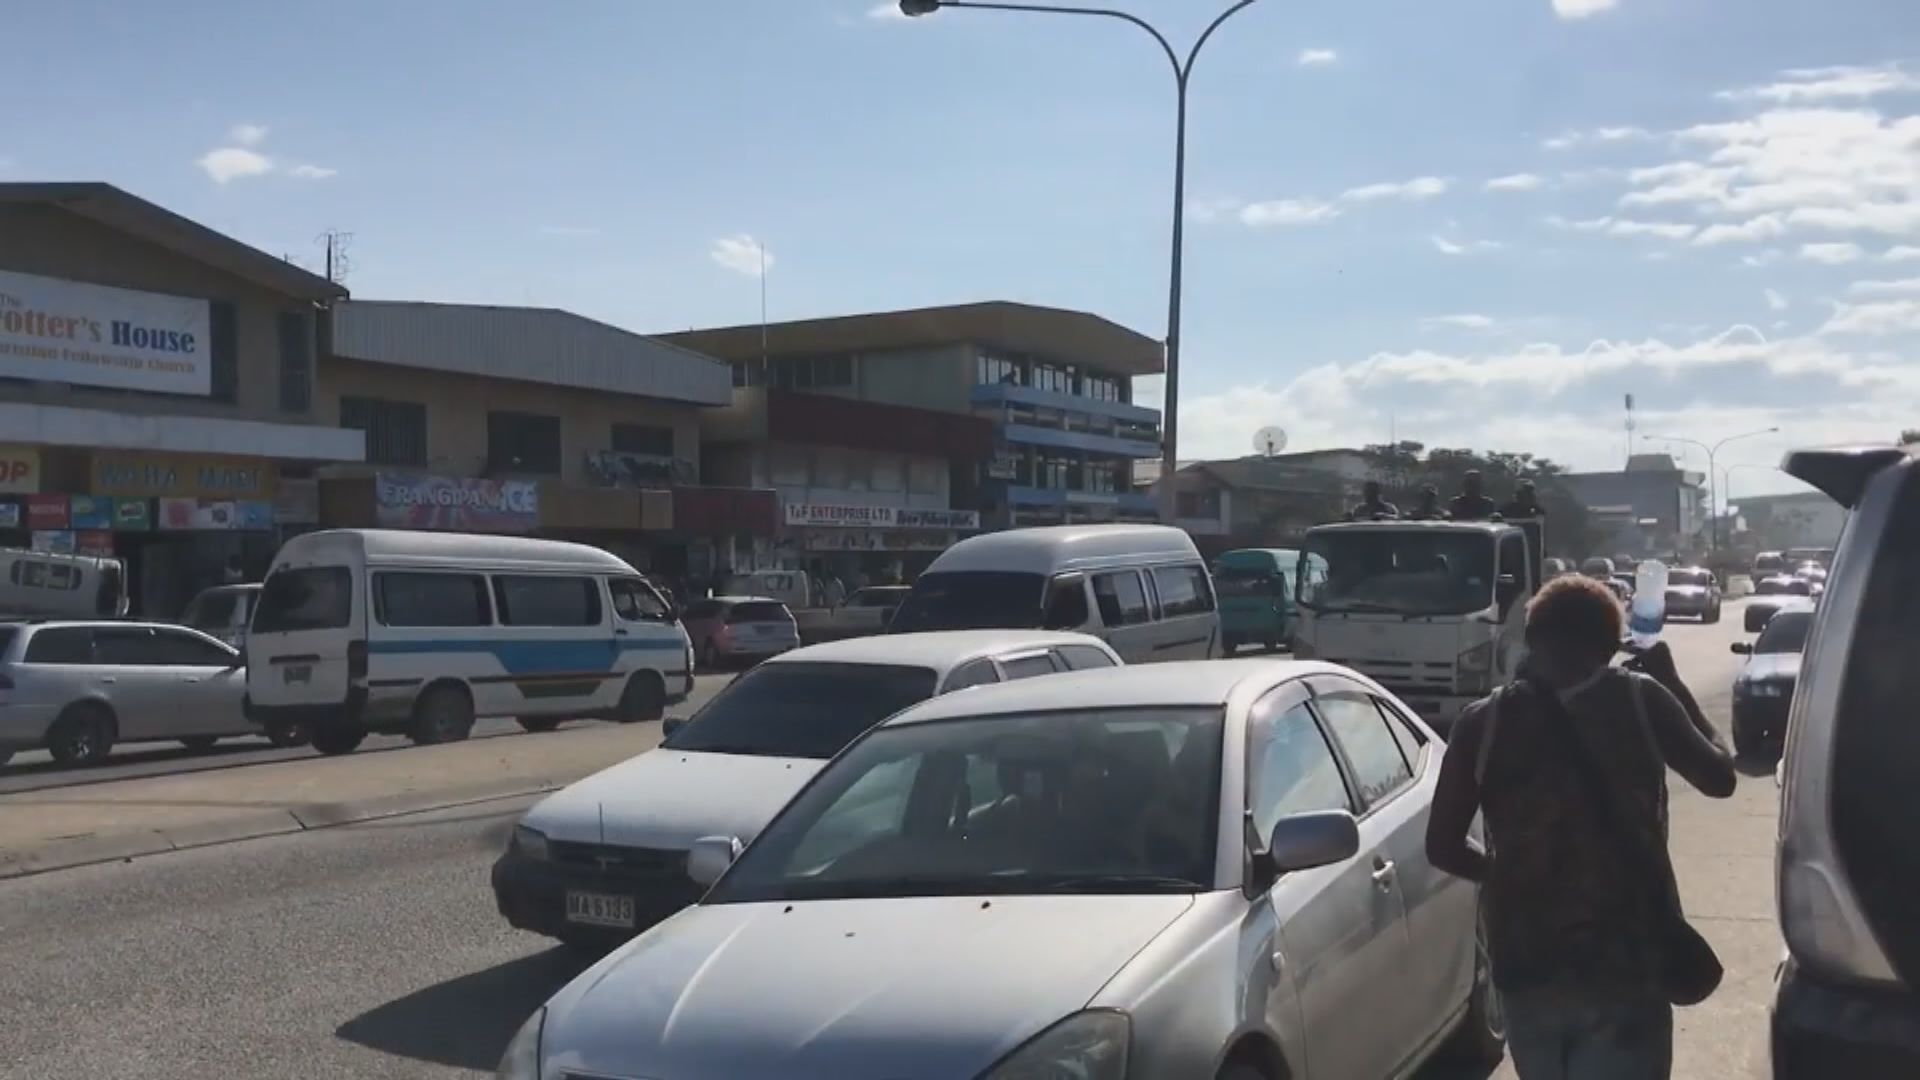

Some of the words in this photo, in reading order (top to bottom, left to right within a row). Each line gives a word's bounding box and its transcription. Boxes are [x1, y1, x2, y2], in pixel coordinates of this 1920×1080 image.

[0, 309, 102, 343] otter's
[111, 320, 195, 353] House
[501, 480, 537, 512] ICE
[810, 506, 870, 520] ENTERPRISE
